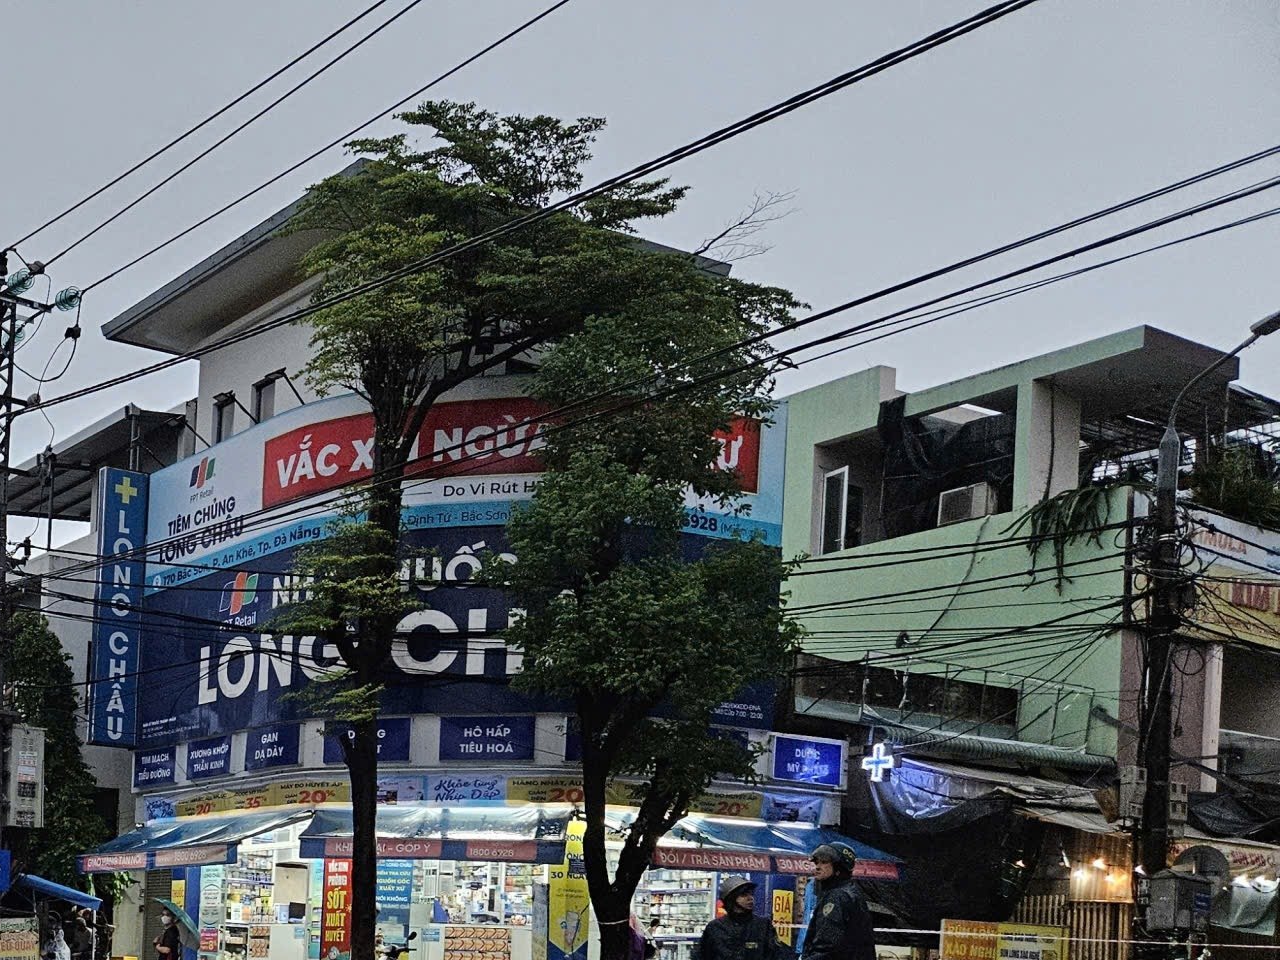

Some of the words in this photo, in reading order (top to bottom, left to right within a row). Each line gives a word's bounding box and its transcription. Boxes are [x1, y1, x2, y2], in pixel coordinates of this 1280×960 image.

[276, 434, 340, 489] VẮC
[443, 485, 465, 497] Do
[470, 482, 486, 495] Vi
[490, 480, 518, 494] Rút
[168, 514, 191, 537] TIÊM
[159, 536, 197, 563] LONG
[201, 514, 244, 549] CHÂU
[222, 552, 235, 564] An
[274, 533, 287, 547] Đà
[289, 524, 321, 543] Nẵng
[235, 611, 257, 626] Retail
[107, 631, 129, 741] CHÂU
[261, 731, 279, 744] GAN
[464, 726, 482, 737] HÔ
[486, 723, 511, 737] HẤP
[254, 749, 266, 762] DẠ
[267, 745, 284, 758] DÀY
[460, 741, 483, 753] TIÊU
[486, 740, 514, 753] HOÁ
[298, 789, 336, 804] 20%
[470, 848, 490, 856] 1800
[492, 848, 514, 856] 6928
[779, 859, 792, 869] 30
[551, 871, 564, 879] 30
[327, 886, 347, 910] SỐT
[774, 892, 791, 914] GIÁ
[326, 910, 346, 927] XUẤT
